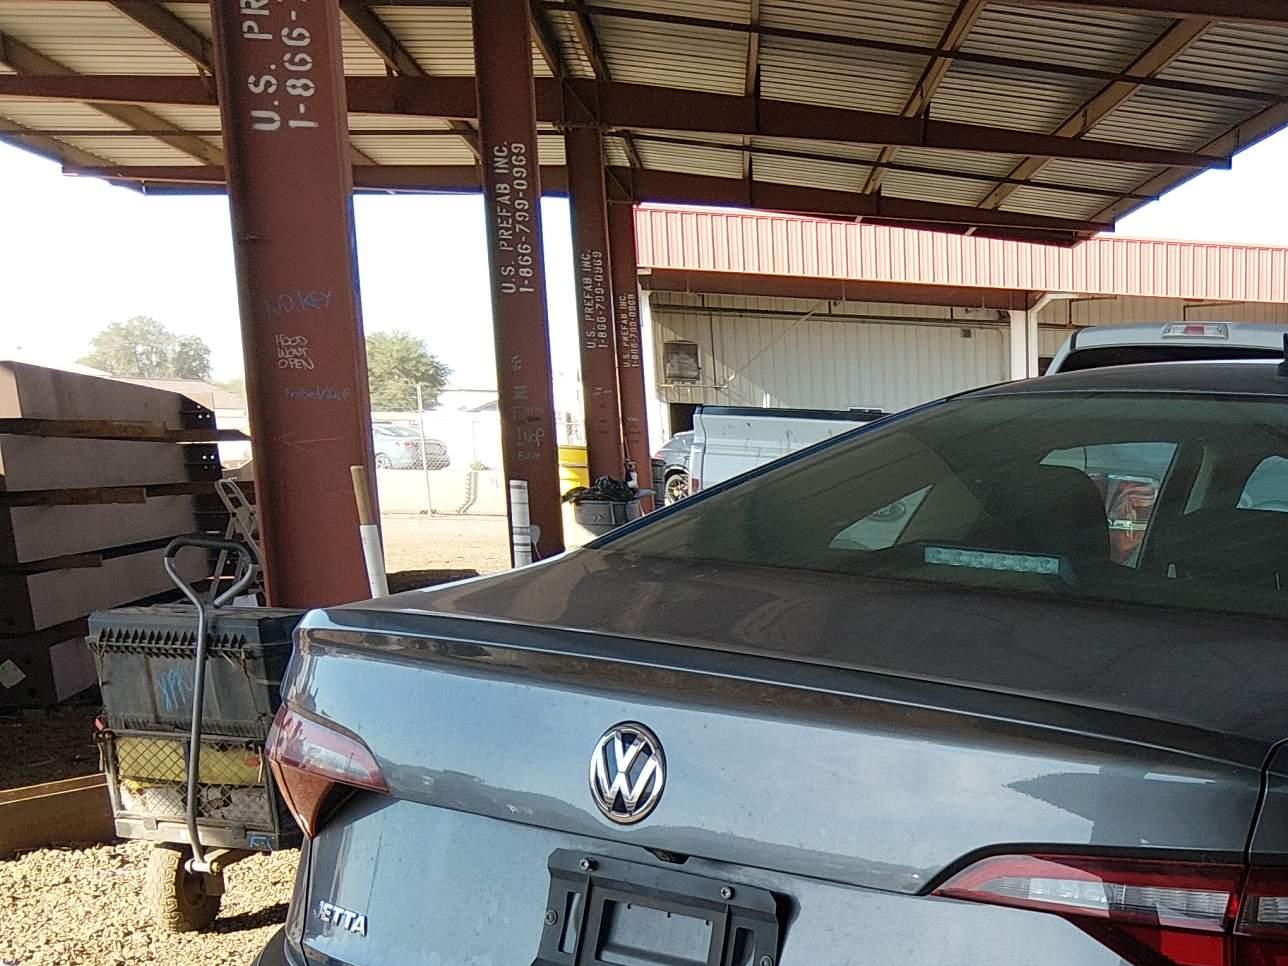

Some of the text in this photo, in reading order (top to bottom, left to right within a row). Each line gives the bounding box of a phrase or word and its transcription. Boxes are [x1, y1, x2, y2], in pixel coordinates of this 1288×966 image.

[245, 64, 281, 131] U.S.
[277, 0, 320, 129] 1-866-
[494, 141, 517, 293] U.S. PREFAB INC.
[511, 143, 535, 292] 1-866-799-0969
[275, 334, 308, 347] HOOD
[580, 250, 597, 349] U.S. PREFAB INC.
[277, 358, 315, 370] OPEN
[590, 725, 664, 820] VW
[312, 900, 369, 938] JETTA
